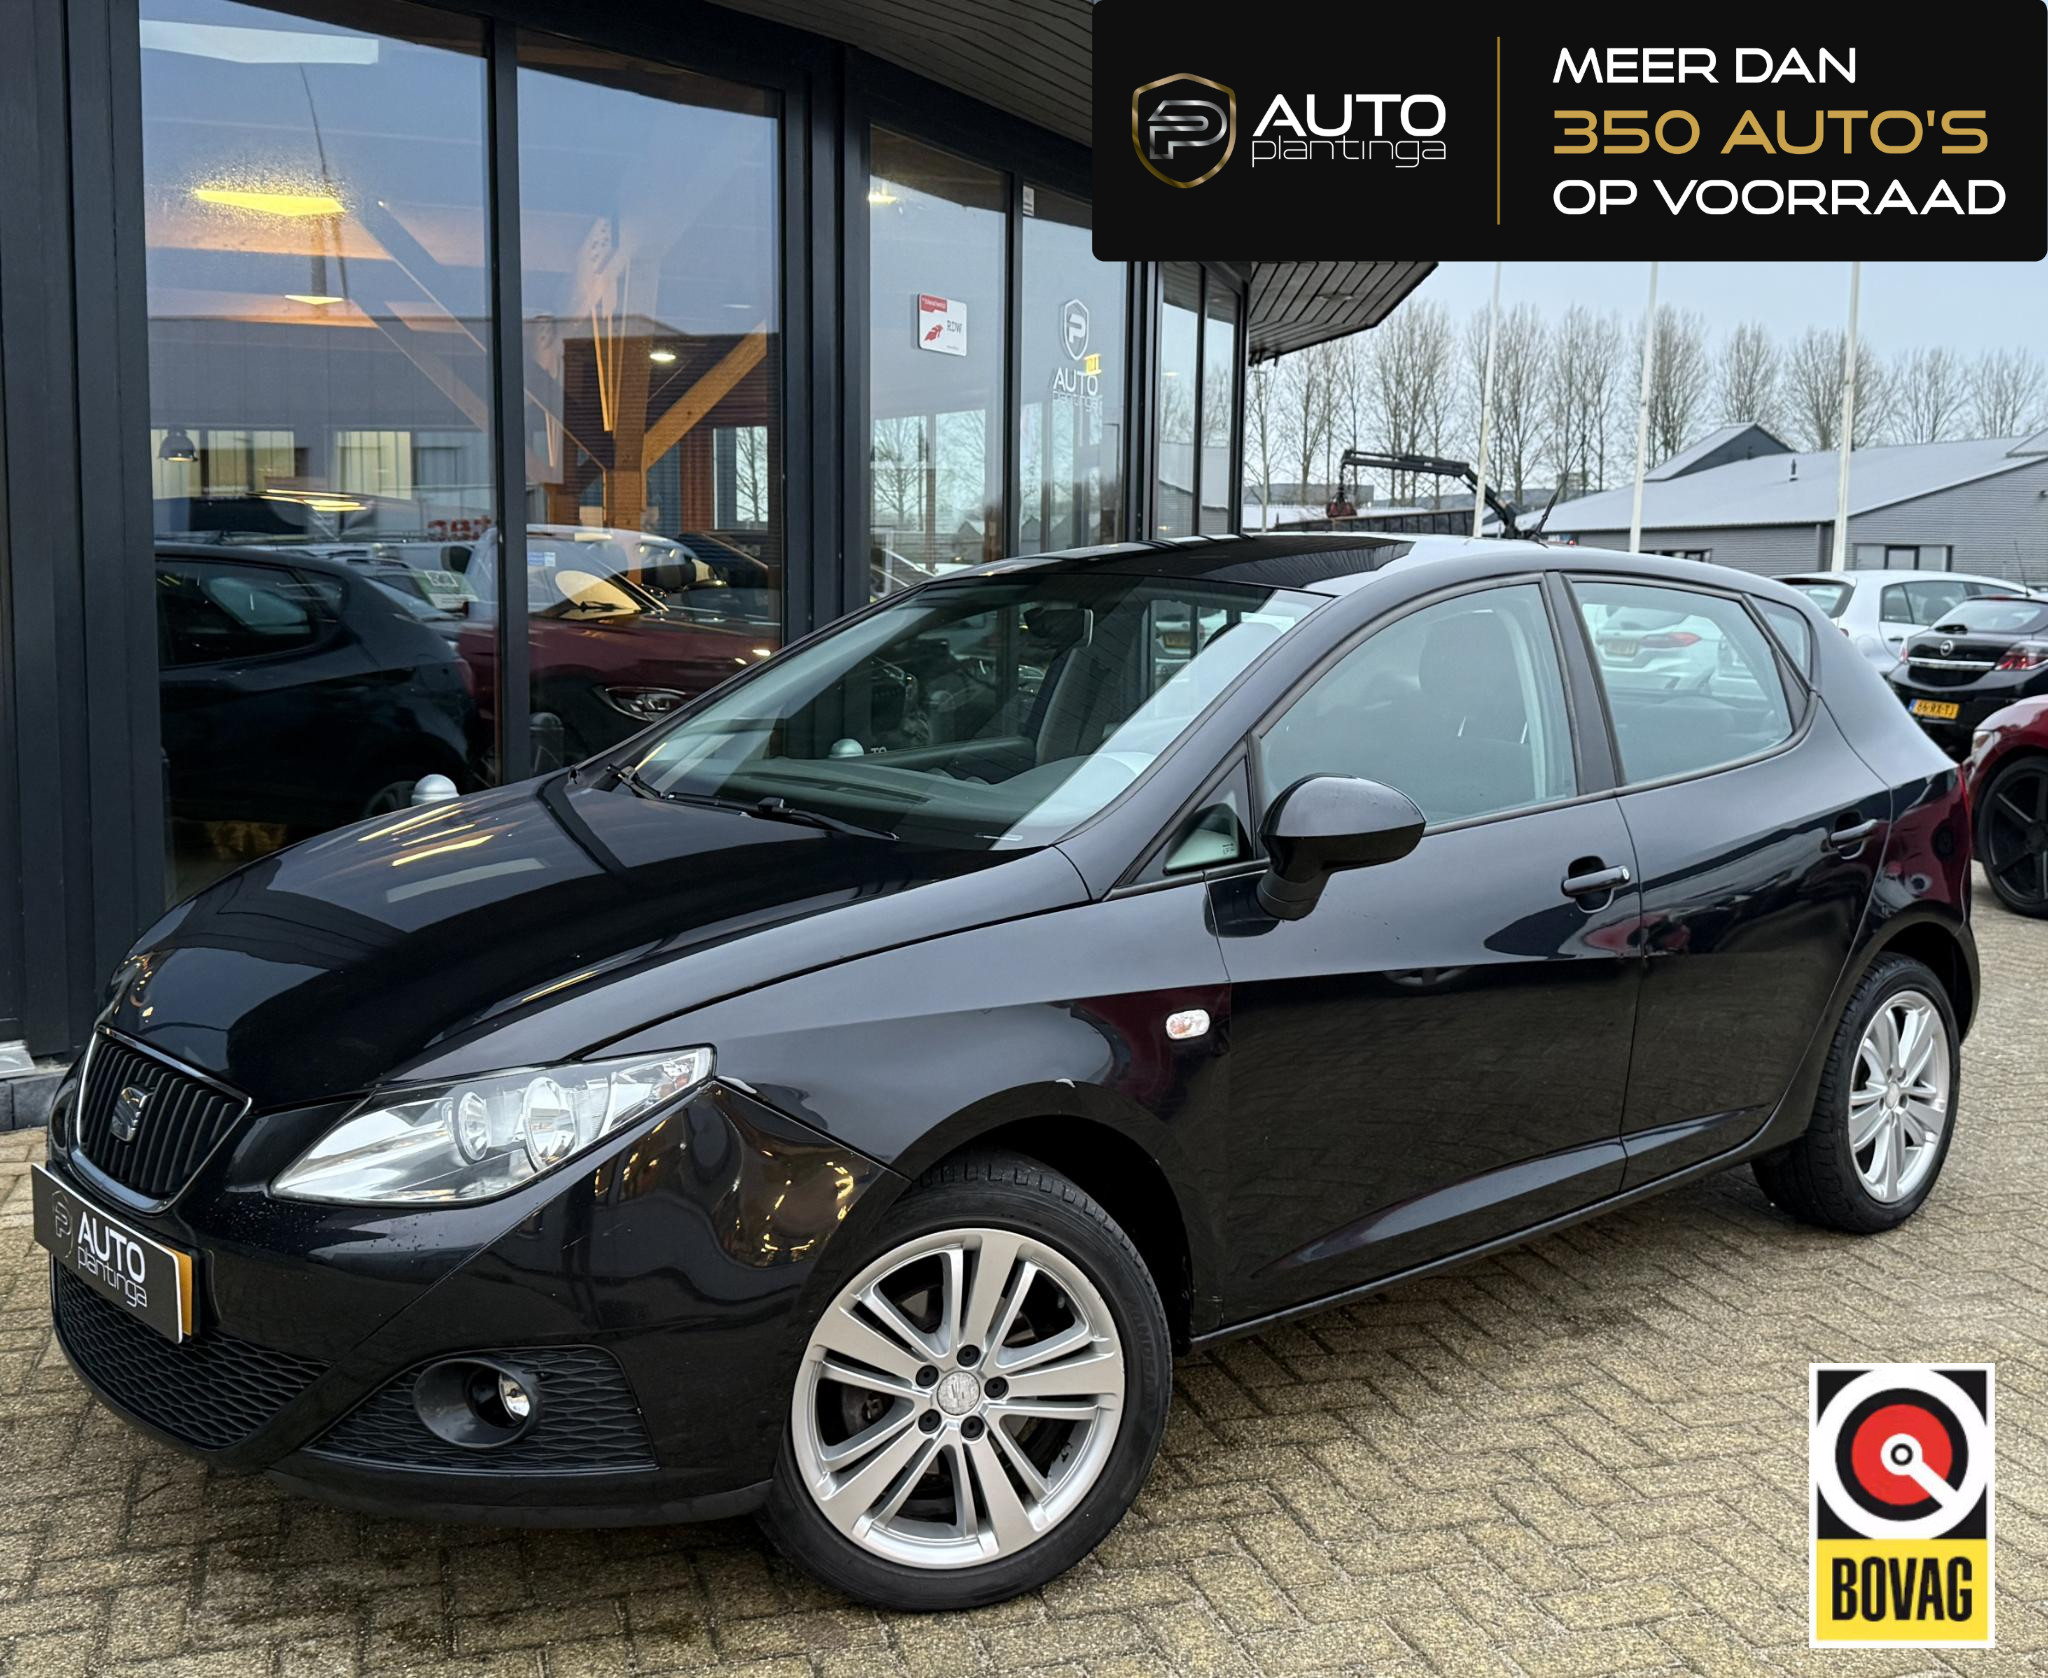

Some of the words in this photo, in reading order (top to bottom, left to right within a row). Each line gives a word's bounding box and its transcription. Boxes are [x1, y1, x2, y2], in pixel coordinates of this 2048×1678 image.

[1053, 367, 1098, 396] AUTO
[77, 1211, 146, 1284] AUTO
[77, 1246, 148, 1308] plantinga
